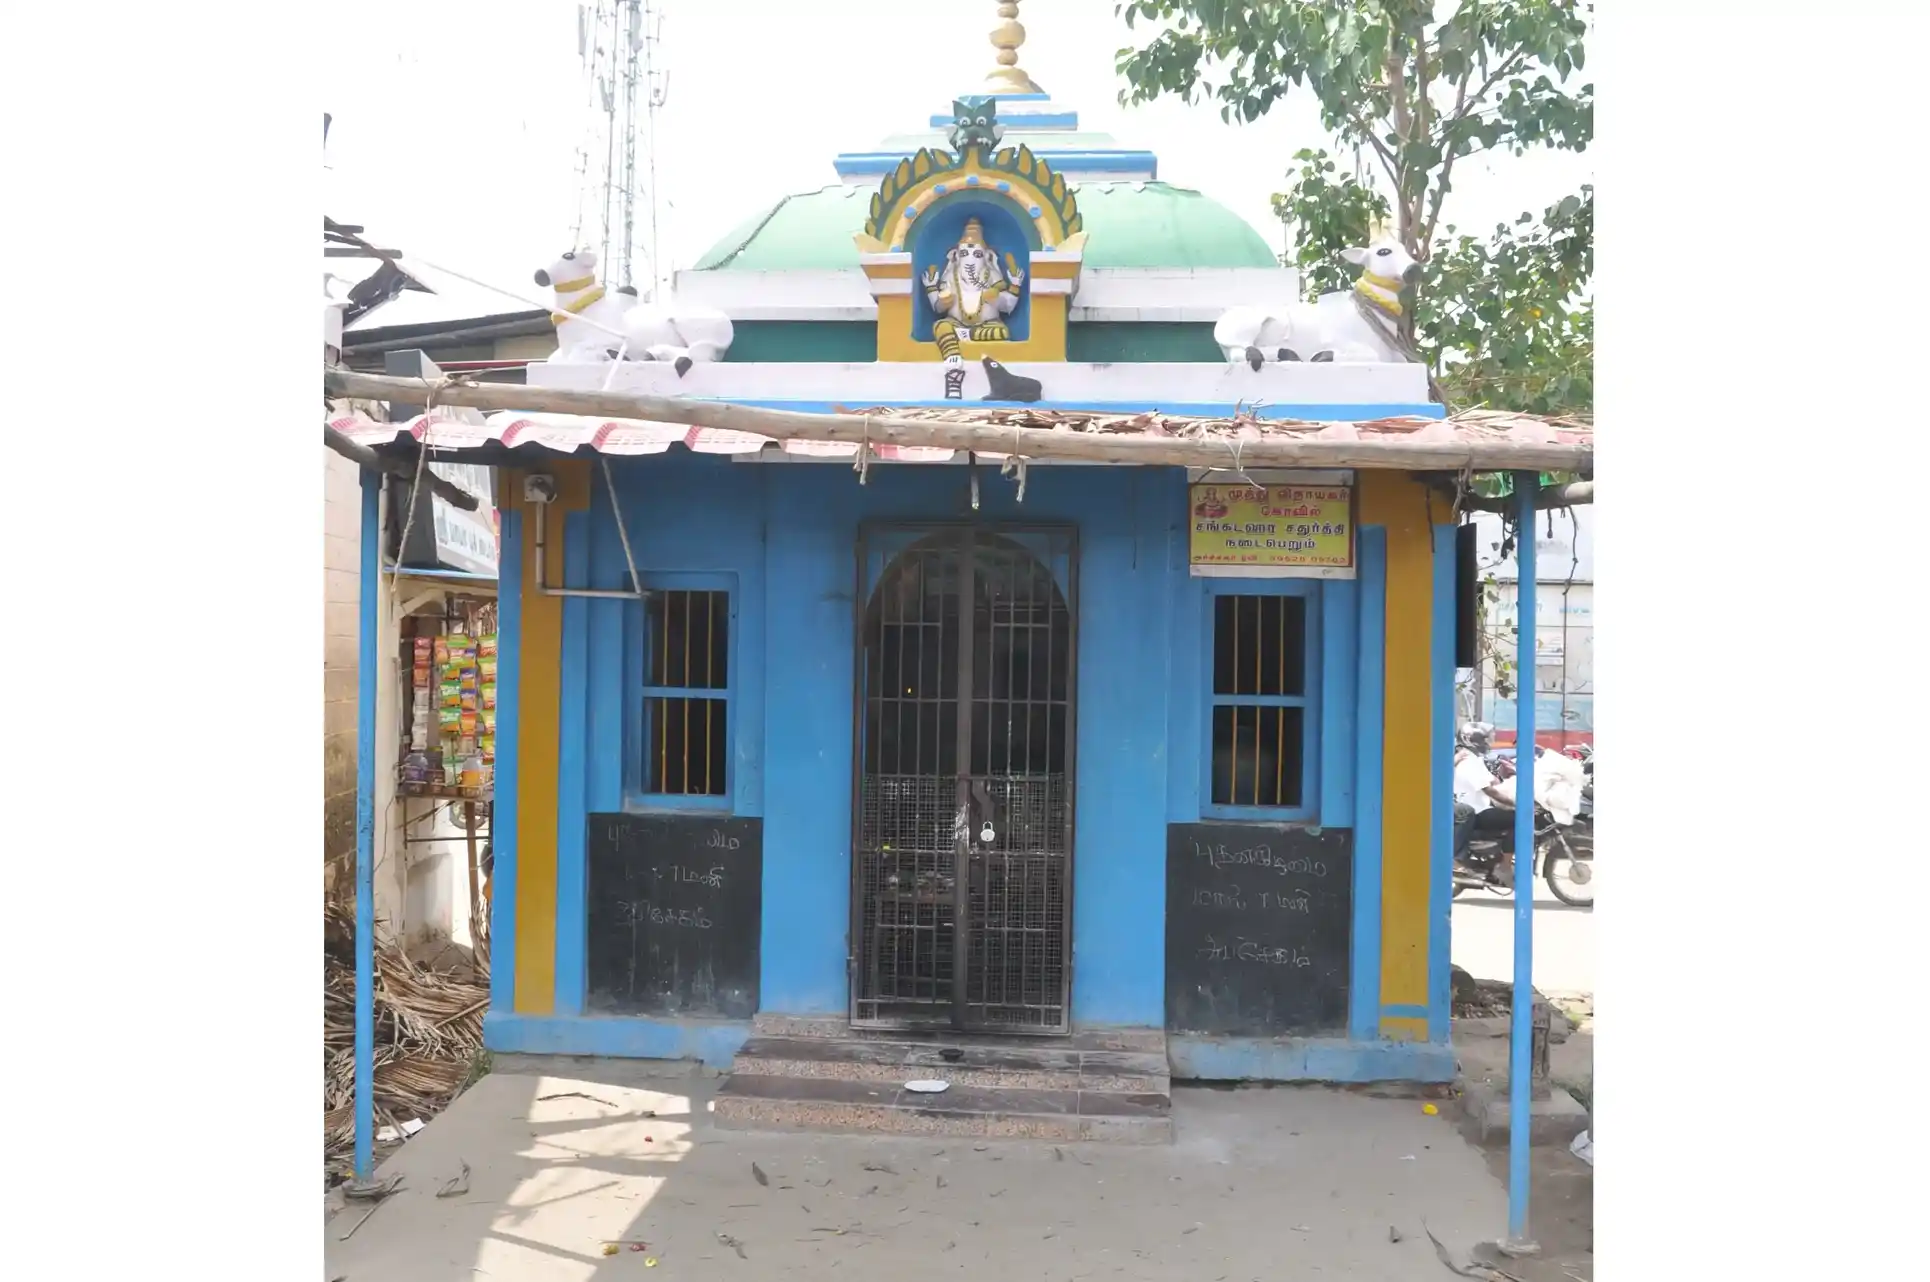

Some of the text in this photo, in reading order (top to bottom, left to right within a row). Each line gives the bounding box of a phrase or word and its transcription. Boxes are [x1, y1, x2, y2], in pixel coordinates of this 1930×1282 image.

[1261, 505, 1322, 518] கோவில்
[1196, 521, 1345, 536] சங்கடஹர சதுர்த்தி
[1225, 538, 1316, 551] நடைபெறும்
